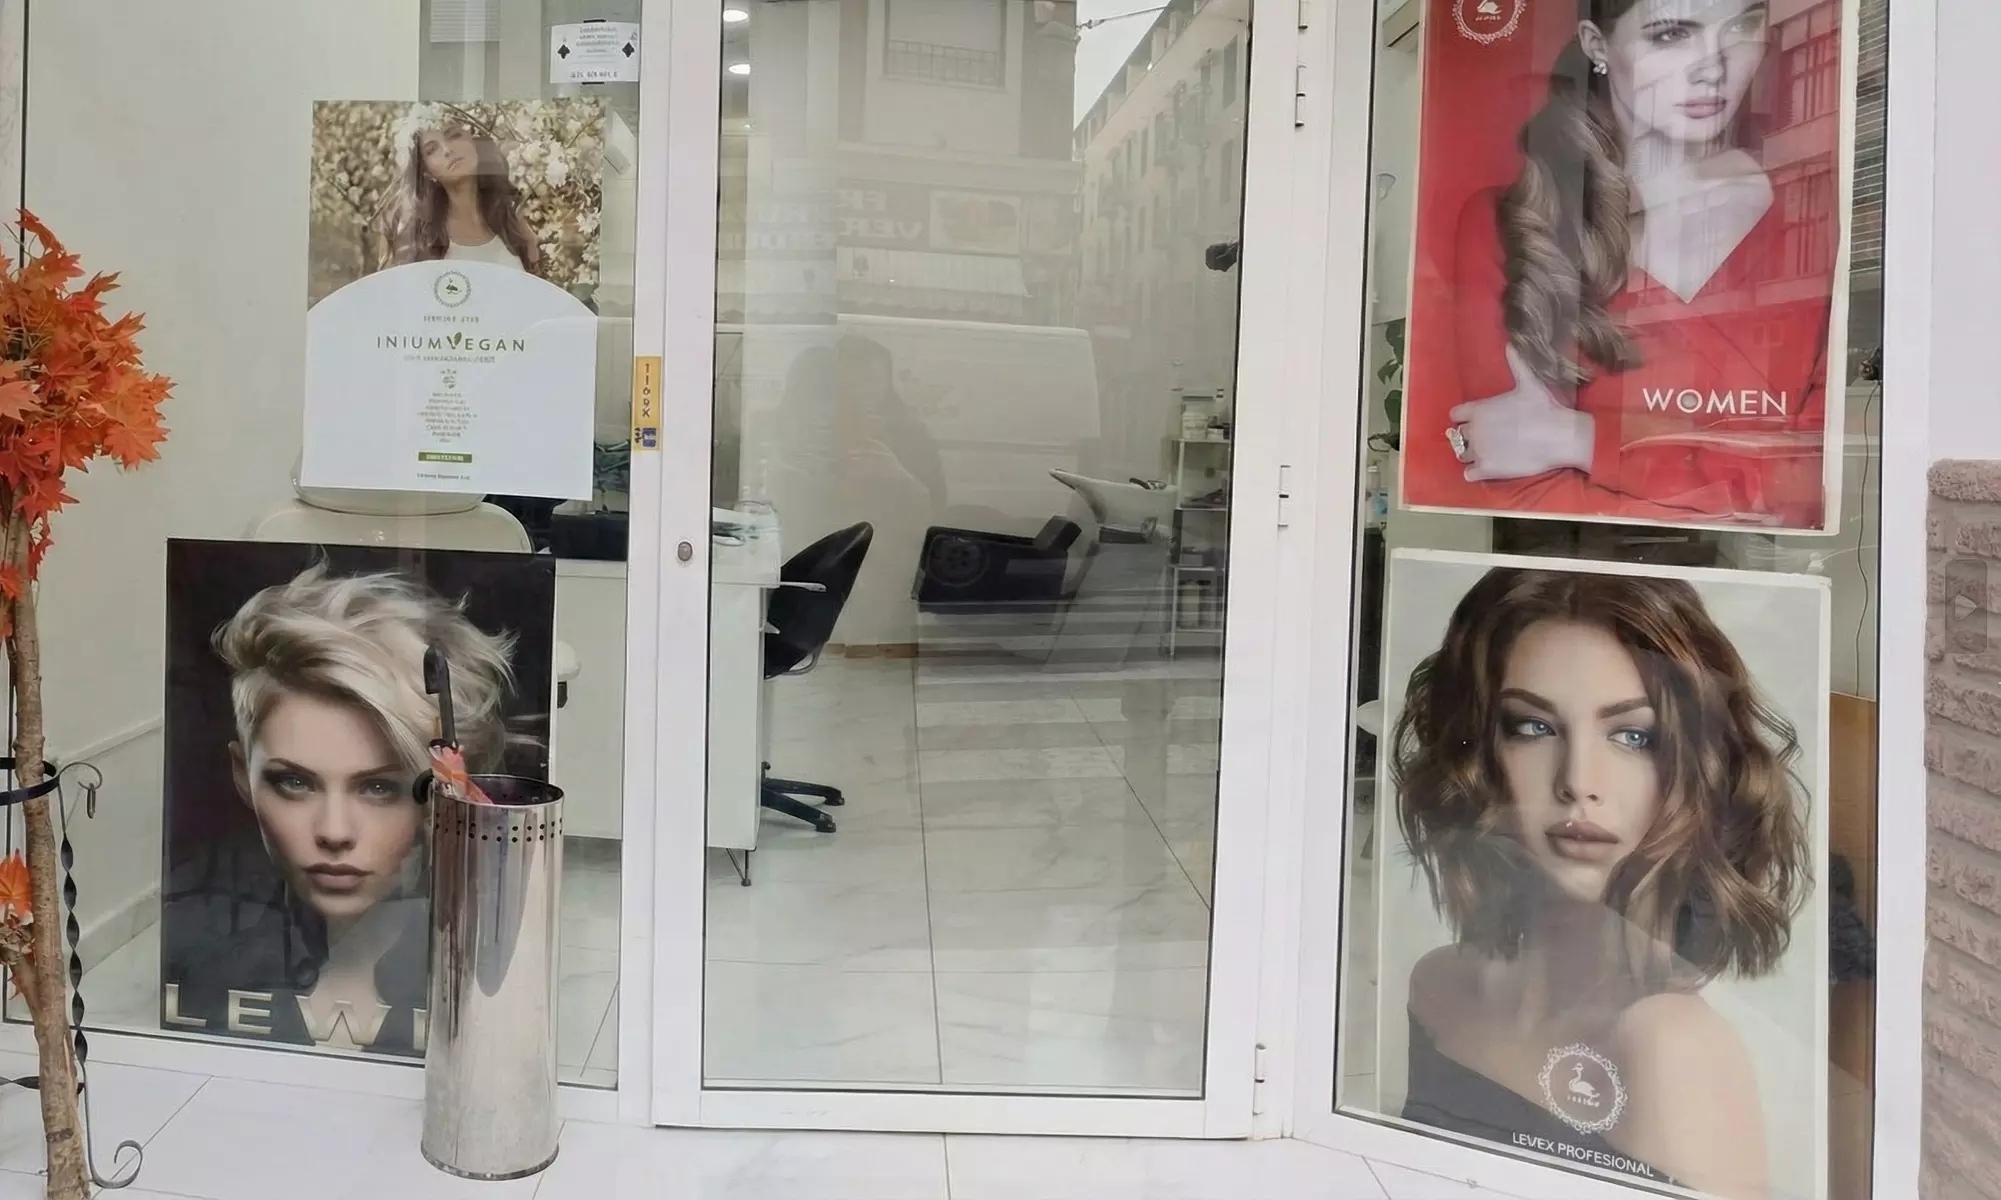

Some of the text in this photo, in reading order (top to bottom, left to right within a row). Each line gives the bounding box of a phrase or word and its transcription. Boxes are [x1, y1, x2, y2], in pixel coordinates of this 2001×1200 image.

[1642, 387, 1787, 416] WOMEN
[1512, 1132, 1654, 1177] LEVEX PROFESIONAL
